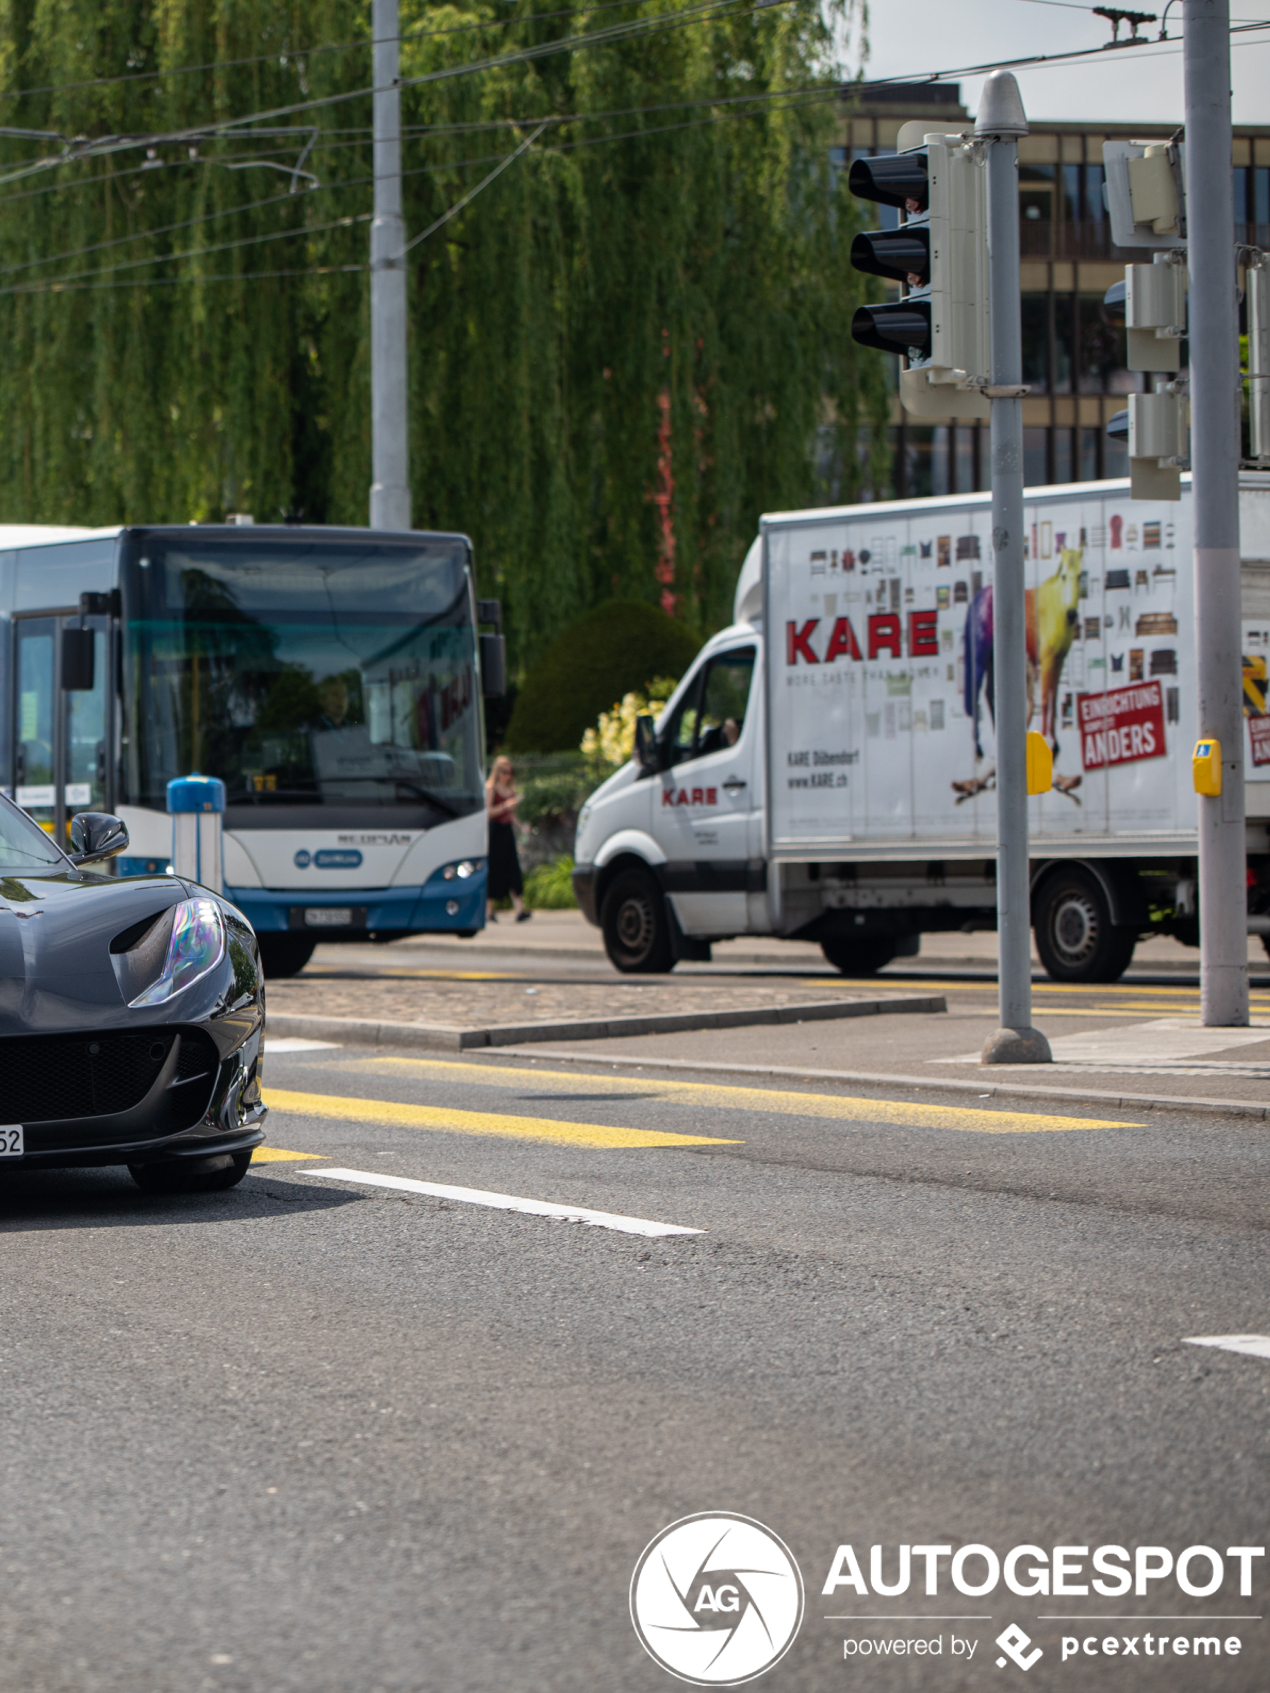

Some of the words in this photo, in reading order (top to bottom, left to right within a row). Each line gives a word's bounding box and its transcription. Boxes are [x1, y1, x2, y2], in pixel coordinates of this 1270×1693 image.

[786, 610, 939, 666] KARE
[822, 670, 856, 686] TASTE
[1081, 684, 1160, 721] EINRICHTUNG
[1085, 721, 1157, 766] ANDERS
[787, 750, 810, 767] KARE
[787, 772, 848, 789] www.KARE.ch
[661, 787, 718, 807] KARE
